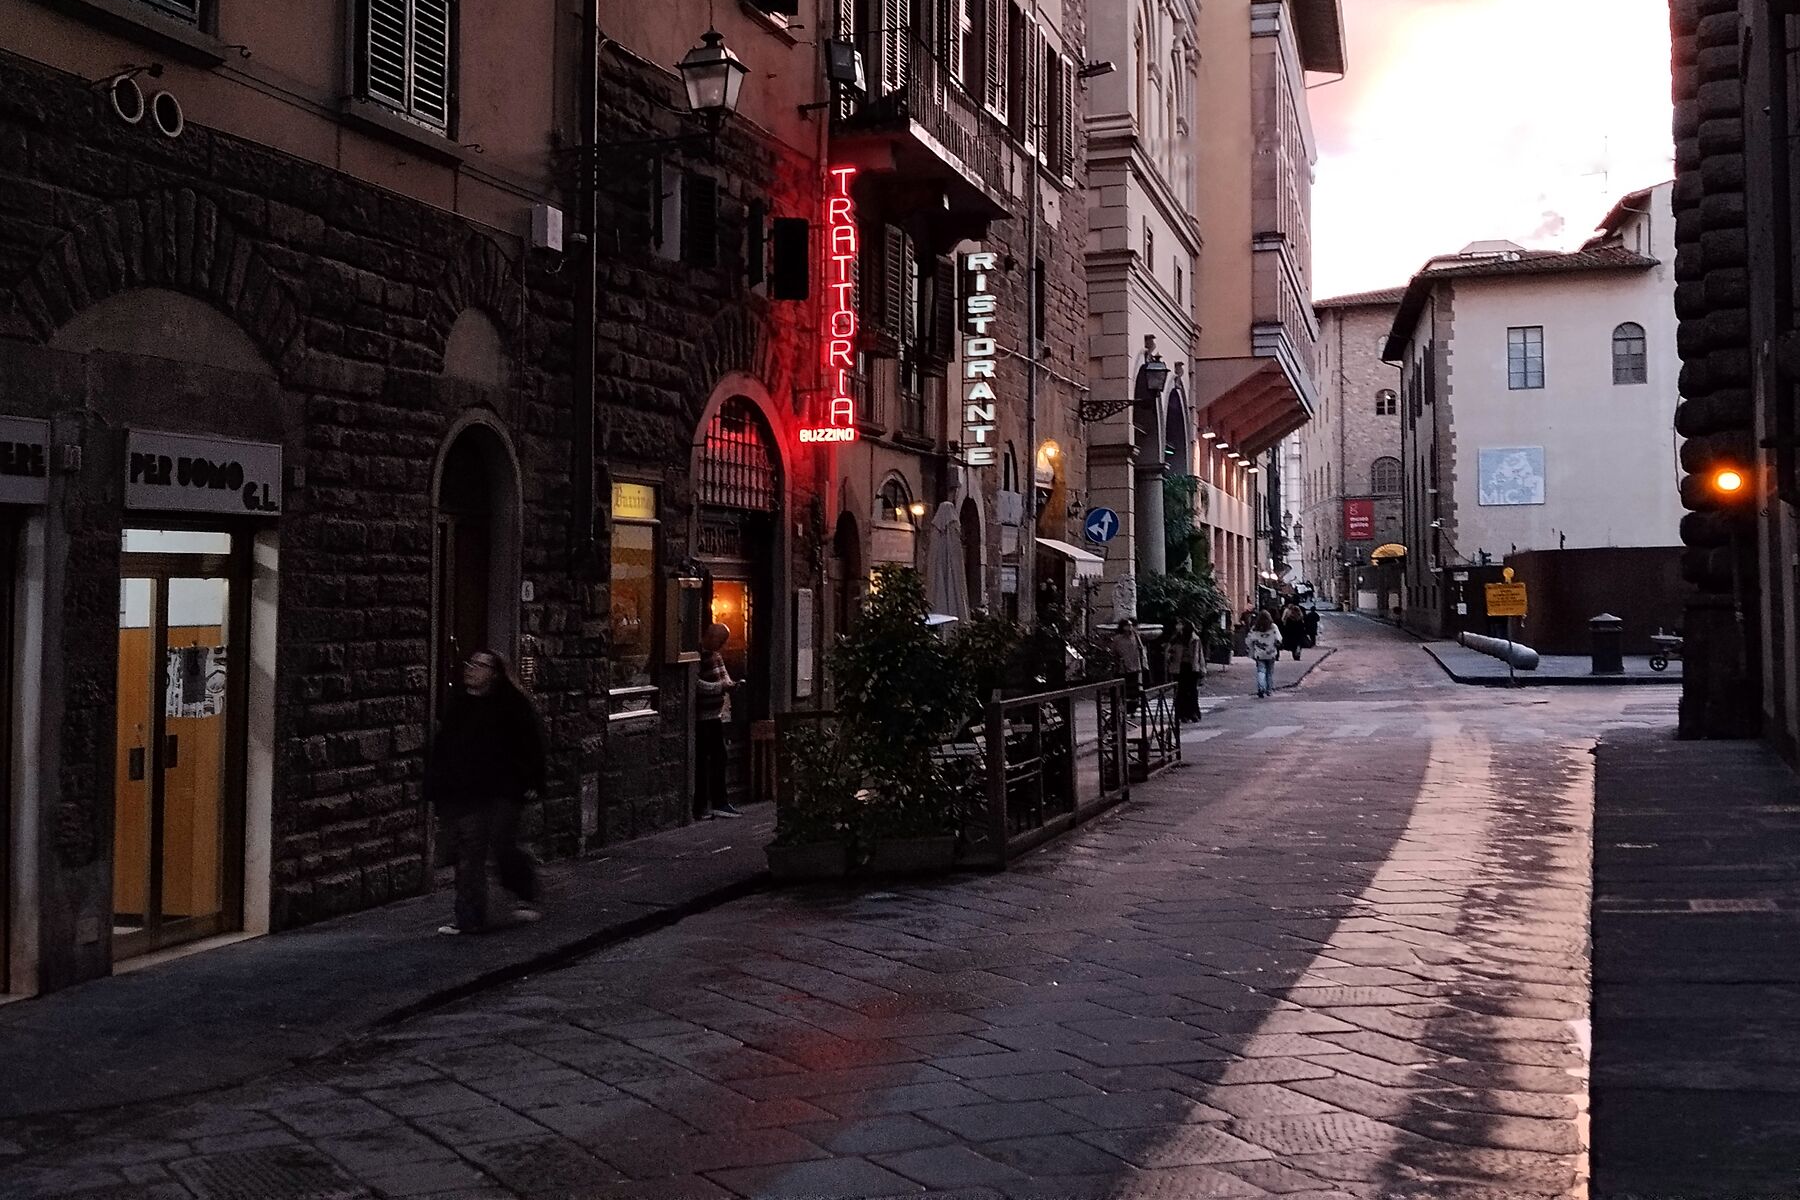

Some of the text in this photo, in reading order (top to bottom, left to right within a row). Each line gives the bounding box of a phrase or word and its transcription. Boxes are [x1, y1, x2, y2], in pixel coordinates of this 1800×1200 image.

[828, 166, 857, 426] TRATTORIA
[966, 252, 998, 466] RISTORANTE
[130, 452, 244, 491] PER UOMO
[799, 428, 855, 443] BUZZINO
